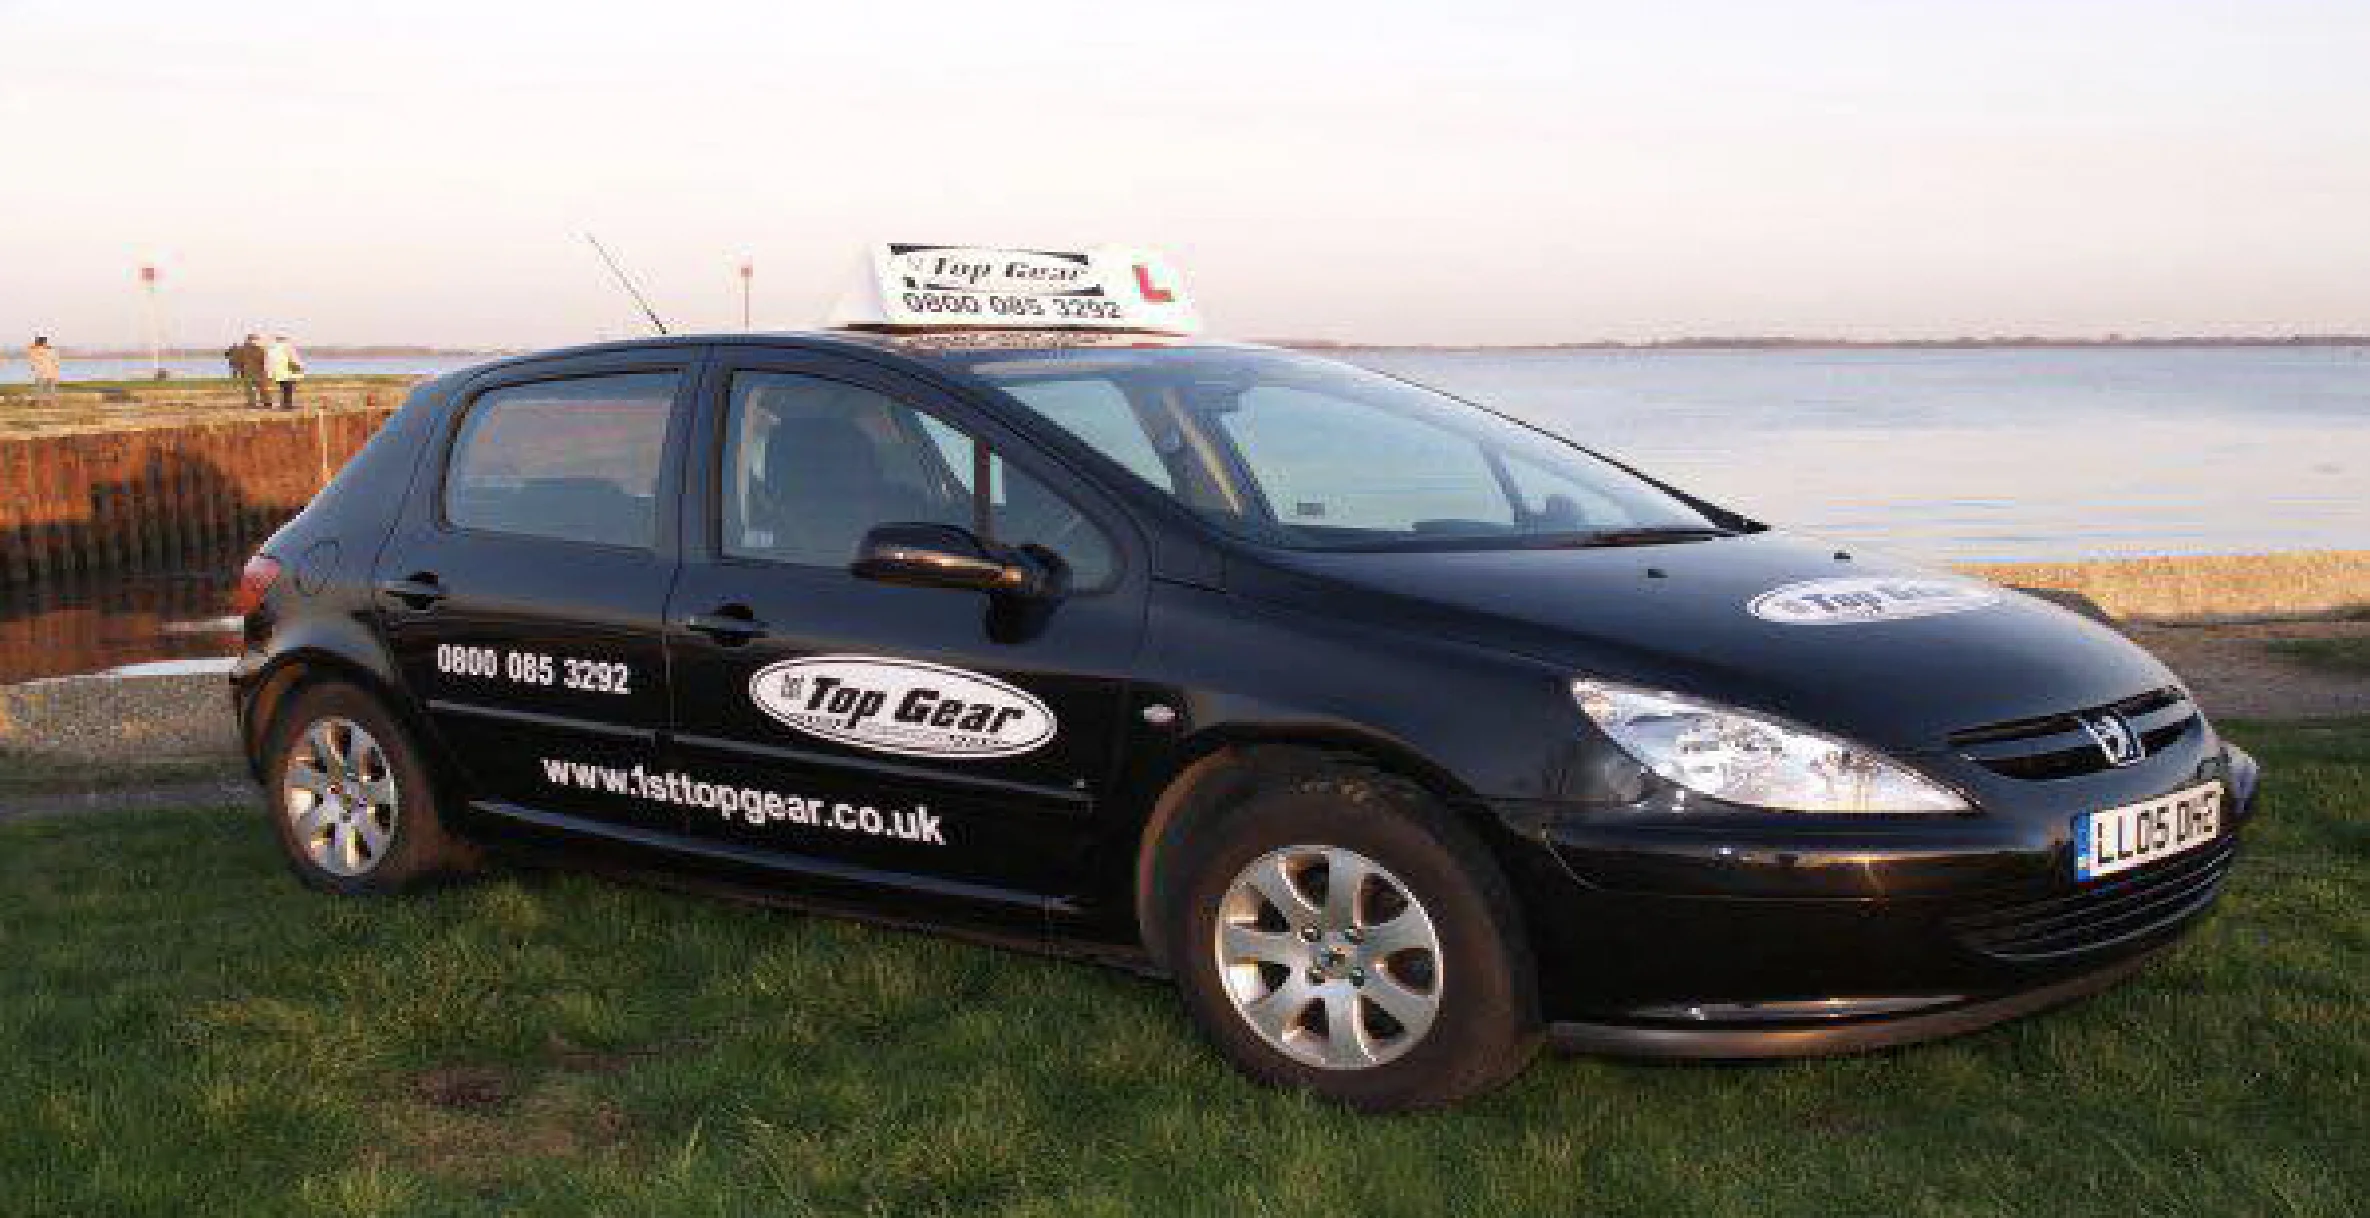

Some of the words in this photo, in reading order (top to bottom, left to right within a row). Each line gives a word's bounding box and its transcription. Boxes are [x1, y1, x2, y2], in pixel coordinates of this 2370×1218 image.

[933, 257, 991, 284] Top
[1131, 264, 1176, 302] L
[902, 292, 982, 314] 0800
[989, 294, 1046, 317] 085
[1057, 297, 1123, 319] 3292
[437, 643, 498, 679] 0800
[508, 649, 554, 686] 085
[563, 659, 632, 695] 3292
[804, 676, 887, 730] Top
[894, 687, 1026, 733] Gear
[540, 756, 947, 846] www.1sttopgear.co.uk
[2097, 806, 2171, 868] LL05
